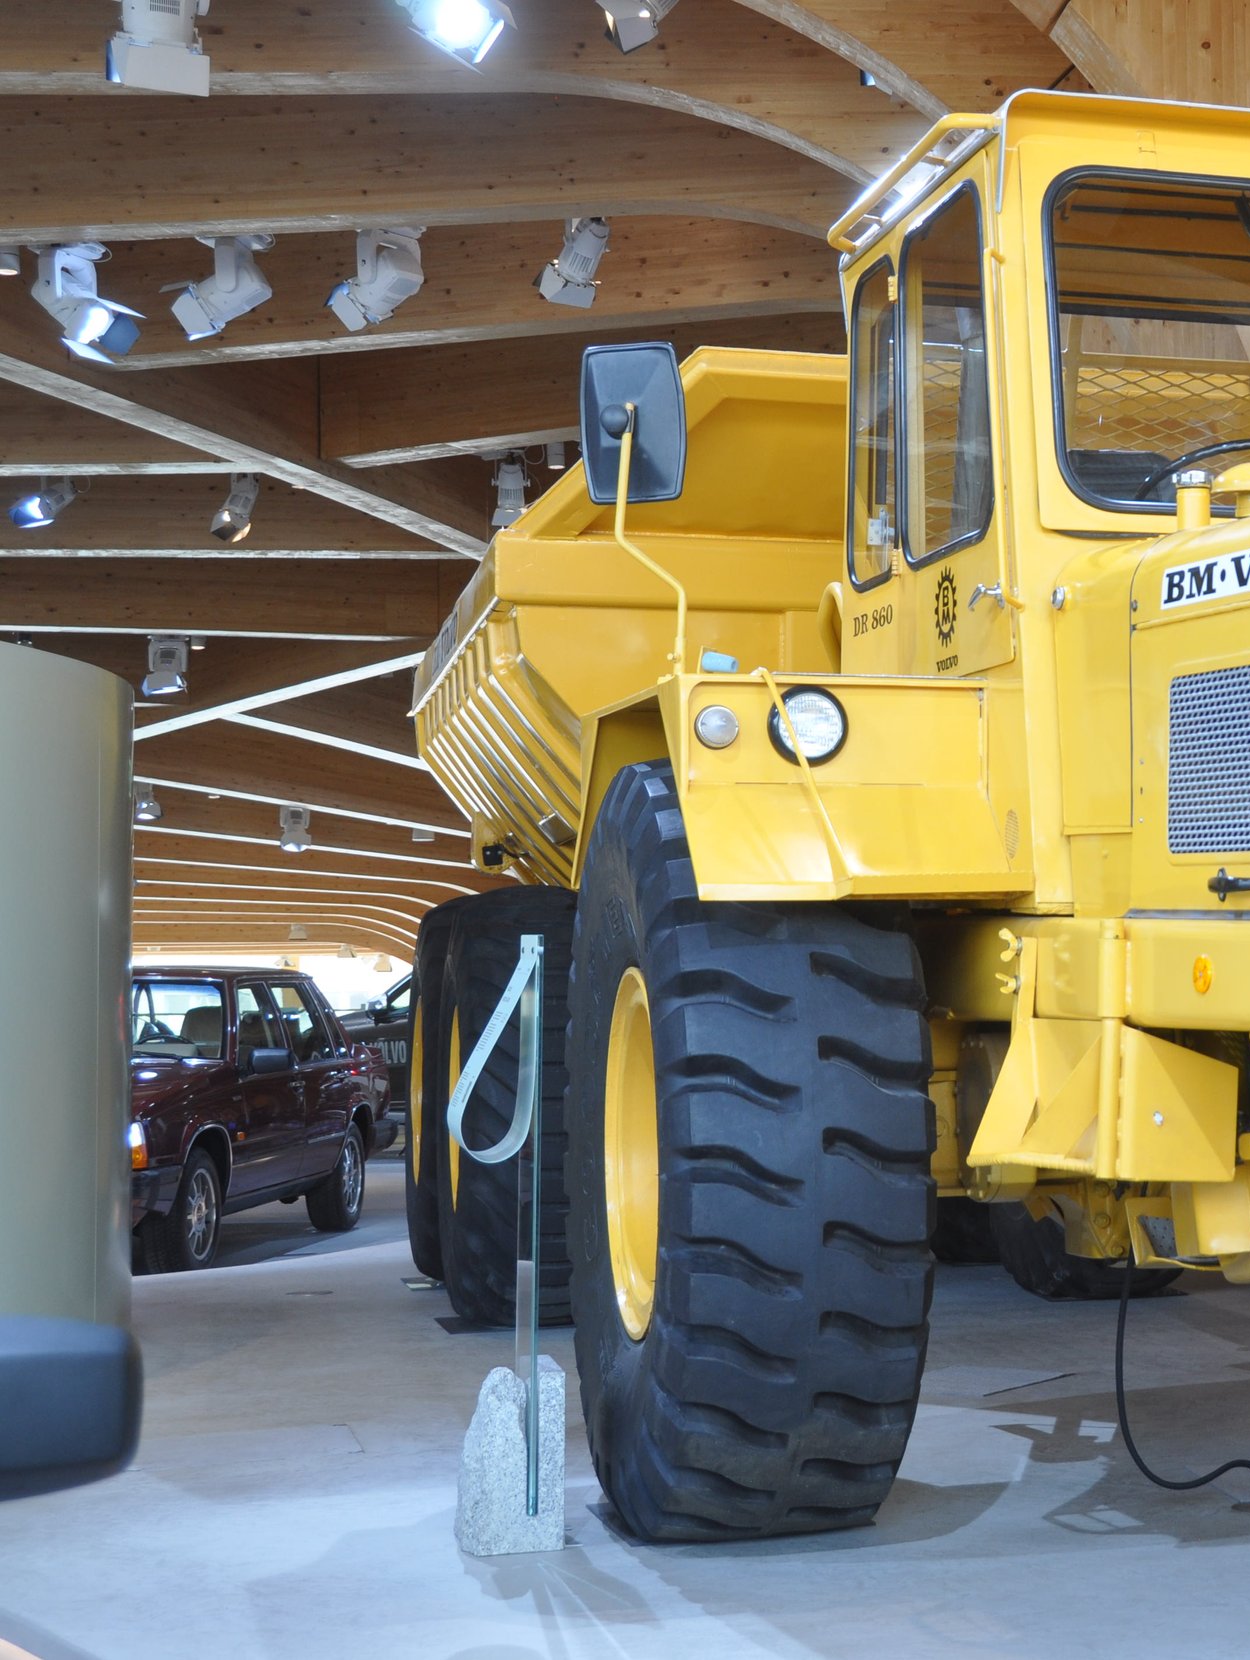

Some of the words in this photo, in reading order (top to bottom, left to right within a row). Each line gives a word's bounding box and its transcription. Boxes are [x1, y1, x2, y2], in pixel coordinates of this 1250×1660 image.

[853, 613, 868, 637] DR
[871, 604, 893, 630] 860
[936, 655, 959, 672] VOLVO
